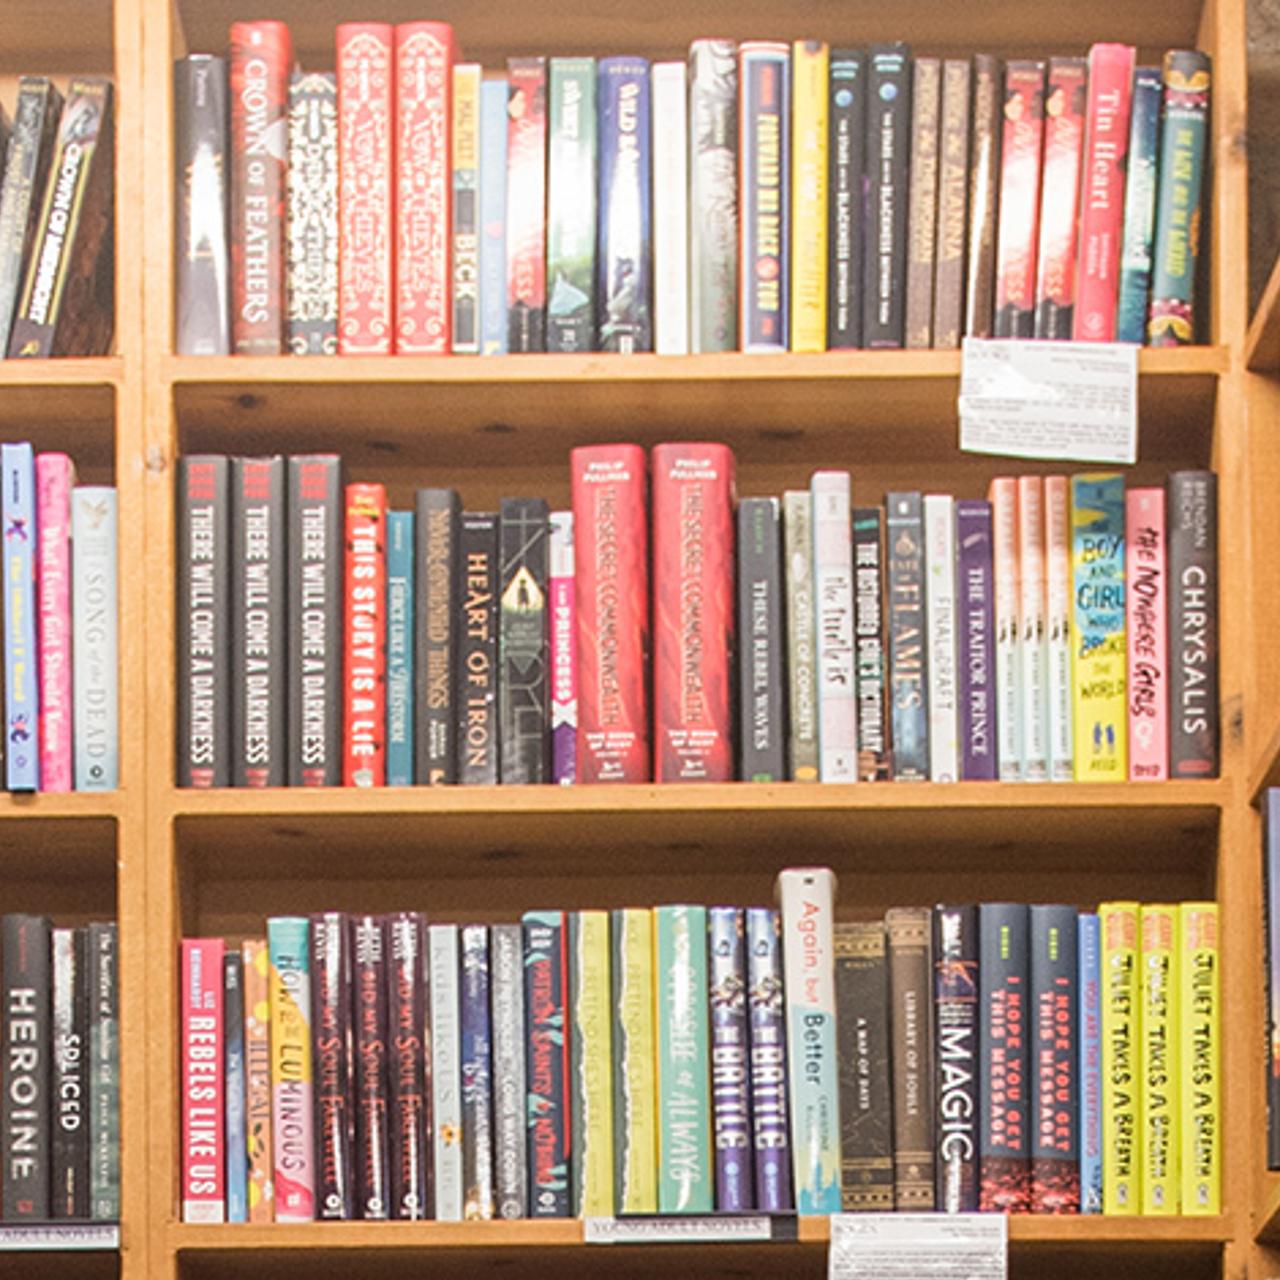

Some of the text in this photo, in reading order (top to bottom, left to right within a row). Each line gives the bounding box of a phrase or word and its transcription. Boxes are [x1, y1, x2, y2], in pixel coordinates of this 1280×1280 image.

[243, 60, 267, 155] CROWN
[1090, 91, 1119, 210] Tin Heart
[245, 196, 267, 323] FEATHERS
[353, 525, 376, 757] THIS STORY IS A LIE
[465, 554, 491, 766] HEART OF IRON
[968, 567, 986, 755] THE TRAITOR PRINCE
[1182, 566, 1206, 734] CHRYSALIS
[9, 988, 38, 1180] HEROINE
[61, 1033, 80, 1131] SPLICED
[188, 1014, 215, 1195] REBELS LIKE US
[940, 1027, 973, 1160] MAGIC
[990, 989, 1006, 1145] THIS MESSAGE
